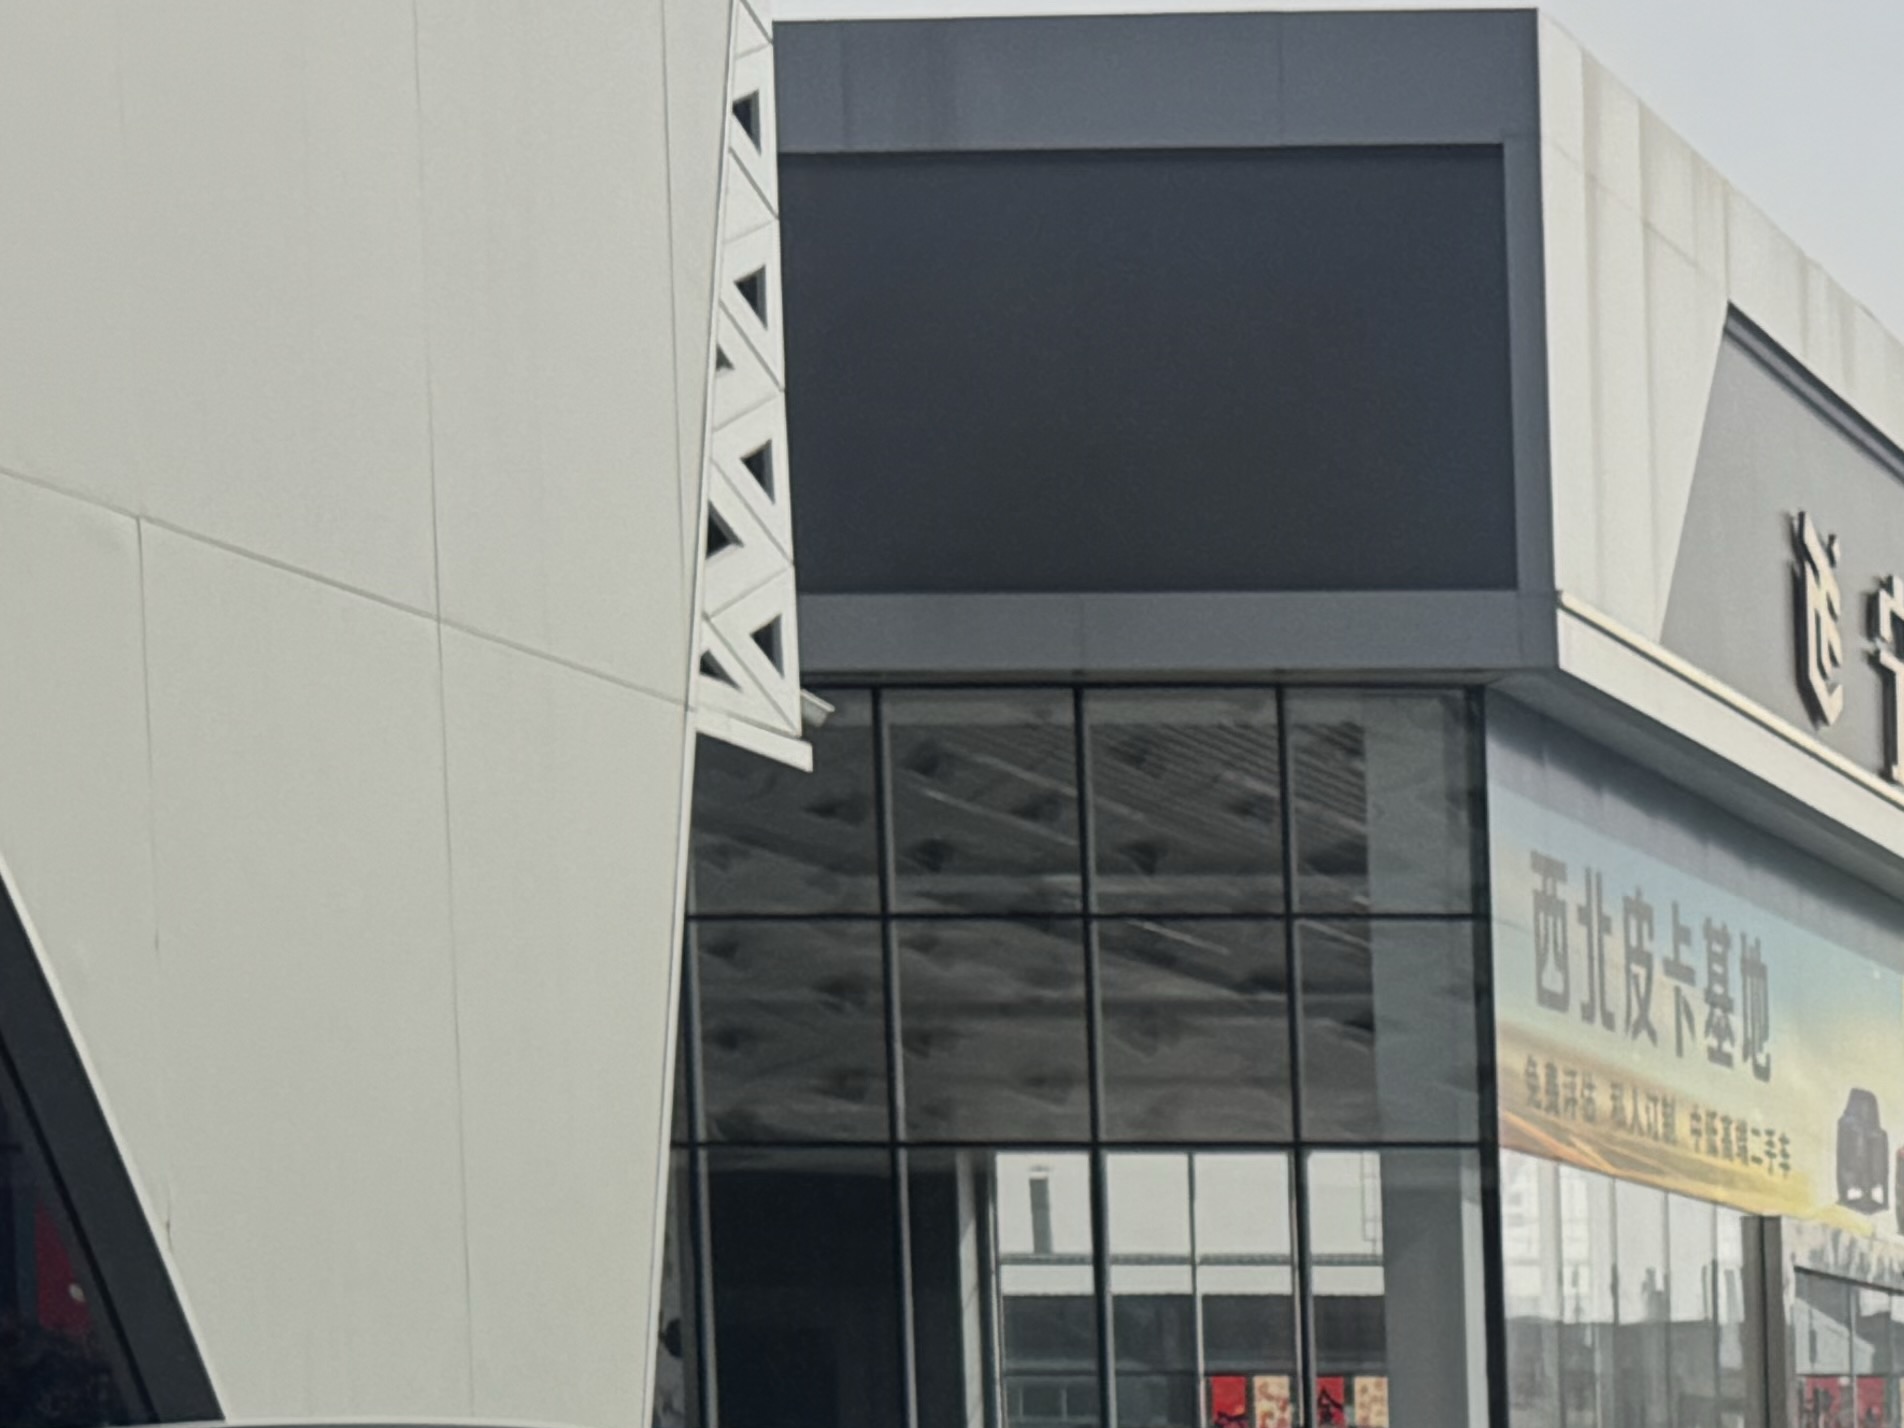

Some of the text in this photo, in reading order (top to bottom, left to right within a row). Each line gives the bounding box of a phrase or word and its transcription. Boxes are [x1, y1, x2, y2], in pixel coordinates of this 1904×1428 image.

[1529, 850, 1771, 1082] 西北皮卡基地
